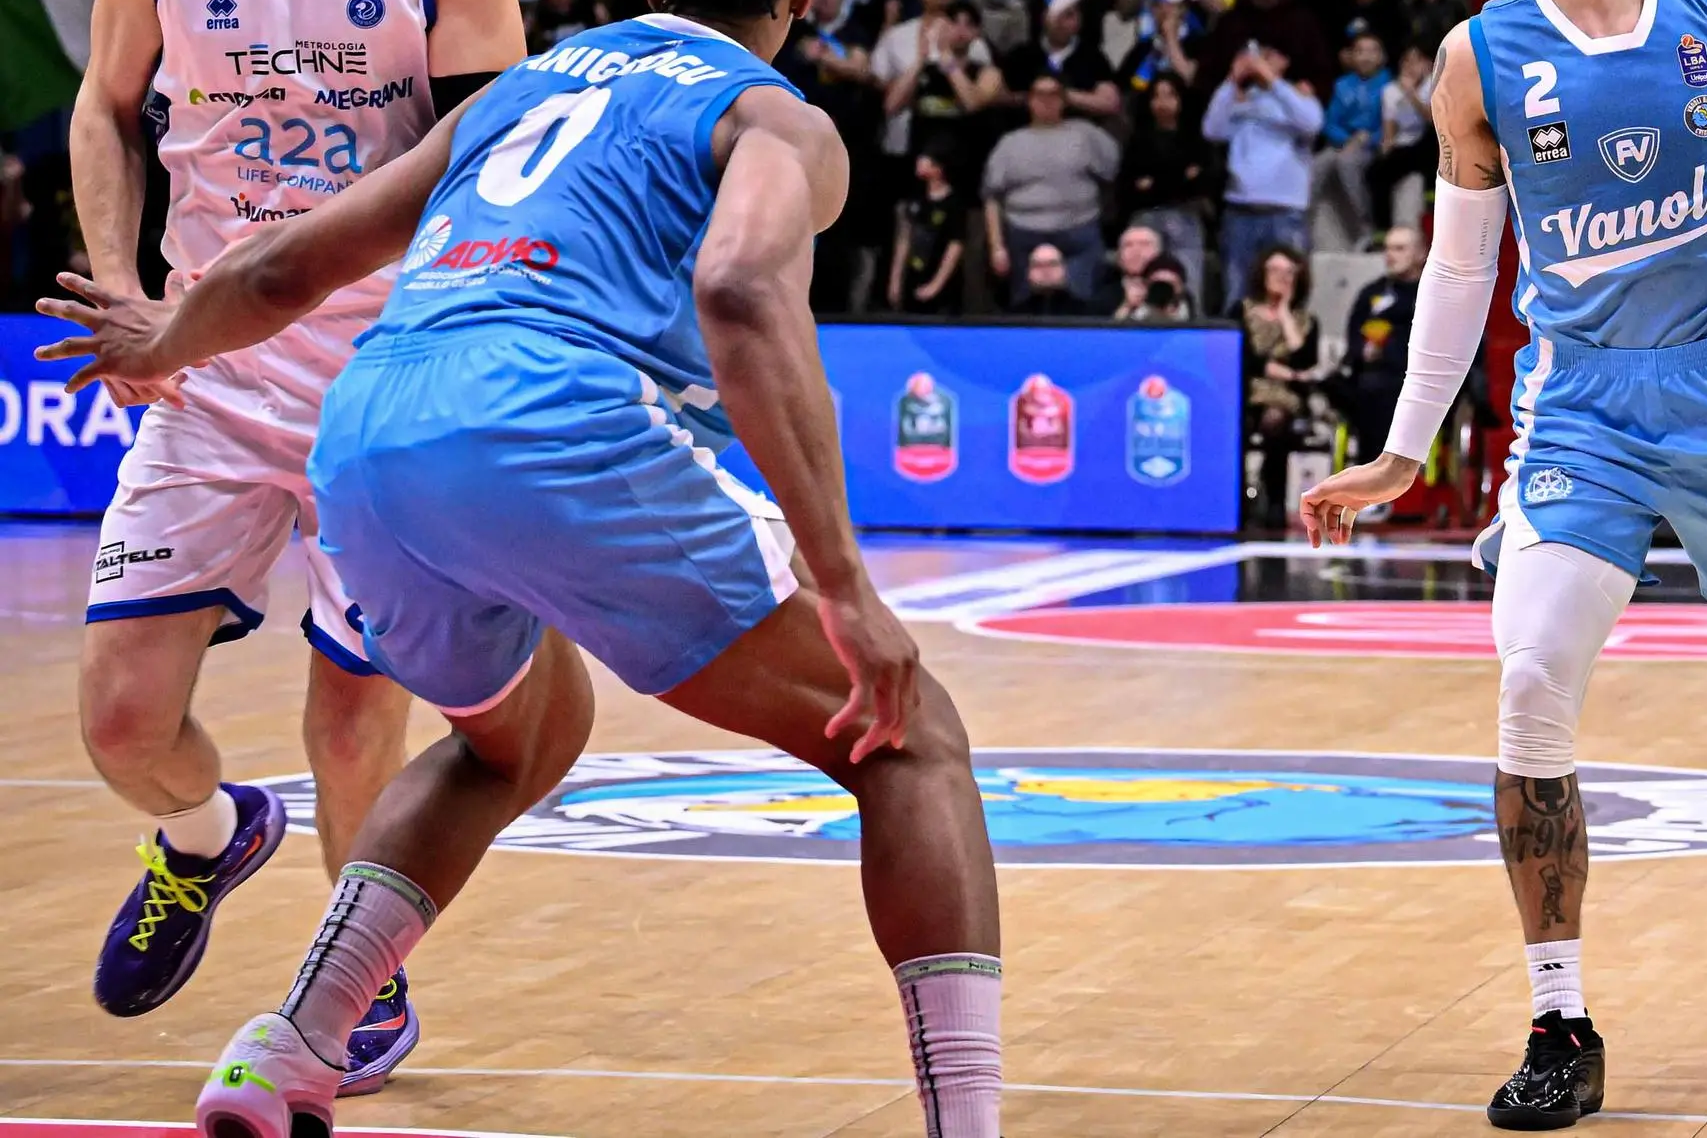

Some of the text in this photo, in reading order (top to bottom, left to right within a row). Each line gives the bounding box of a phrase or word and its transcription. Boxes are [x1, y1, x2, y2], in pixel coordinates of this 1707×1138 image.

[207, 16, 240, 30] errea
[295, 40, 366, 51] METROLOGIA
[225, 44, 367, 76] TECHNE
[1684, 56, 1707, 67] LBA
[314, 77, 414, 110] MEGRANI
[1521, 60, 1561, 119] 2
[234, 117, 363, 175] a2a
[477, 86, 612, 207] 0
[1535, 147, 1569, 162] errea
[237, 166, 270, 183] LIFE
